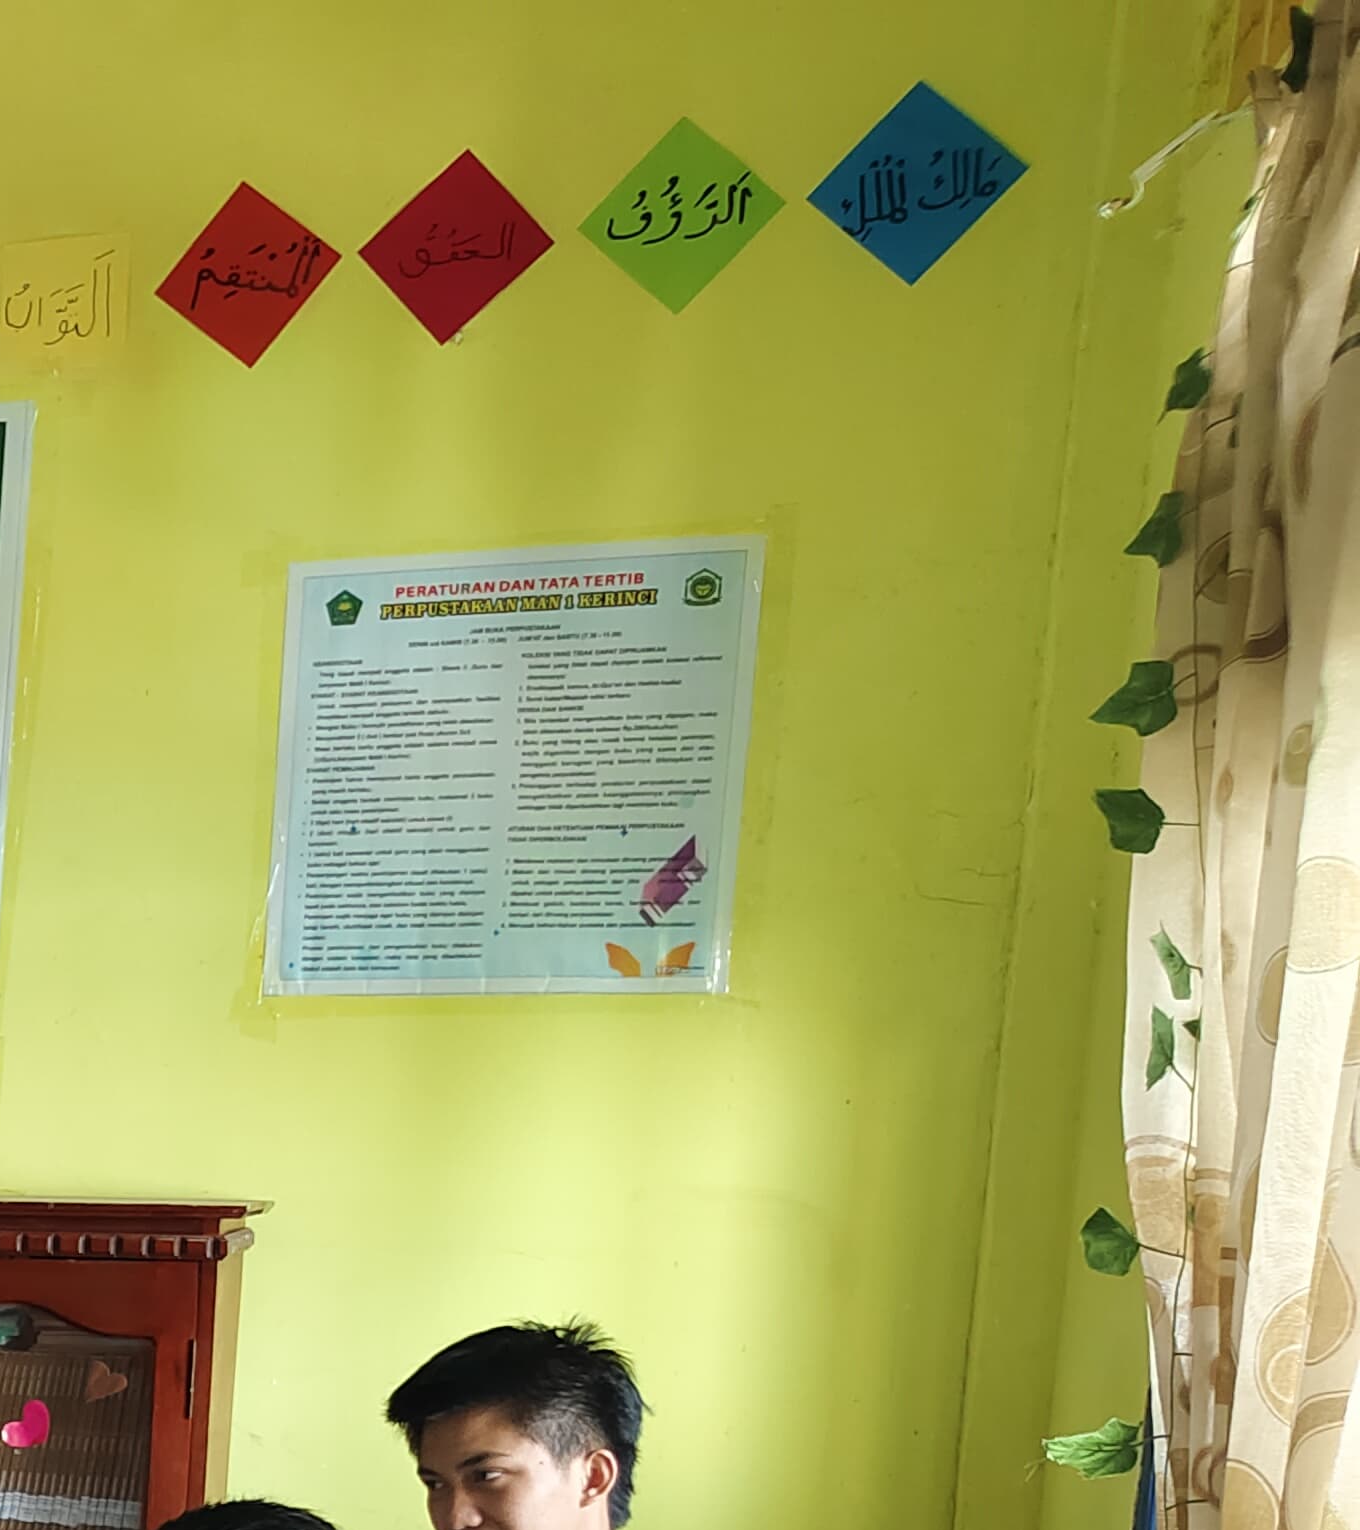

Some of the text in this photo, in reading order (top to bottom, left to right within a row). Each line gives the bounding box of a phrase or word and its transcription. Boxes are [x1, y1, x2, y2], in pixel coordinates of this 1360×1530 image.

[395, 572, 644, 599] PERATURAN DAN TATA TERTIB
[380, 597, 518, 620] PERPUSTAKAAN
[520, 593, 561, 612] MAN
[578, 588, 657, 610] KERINCI
